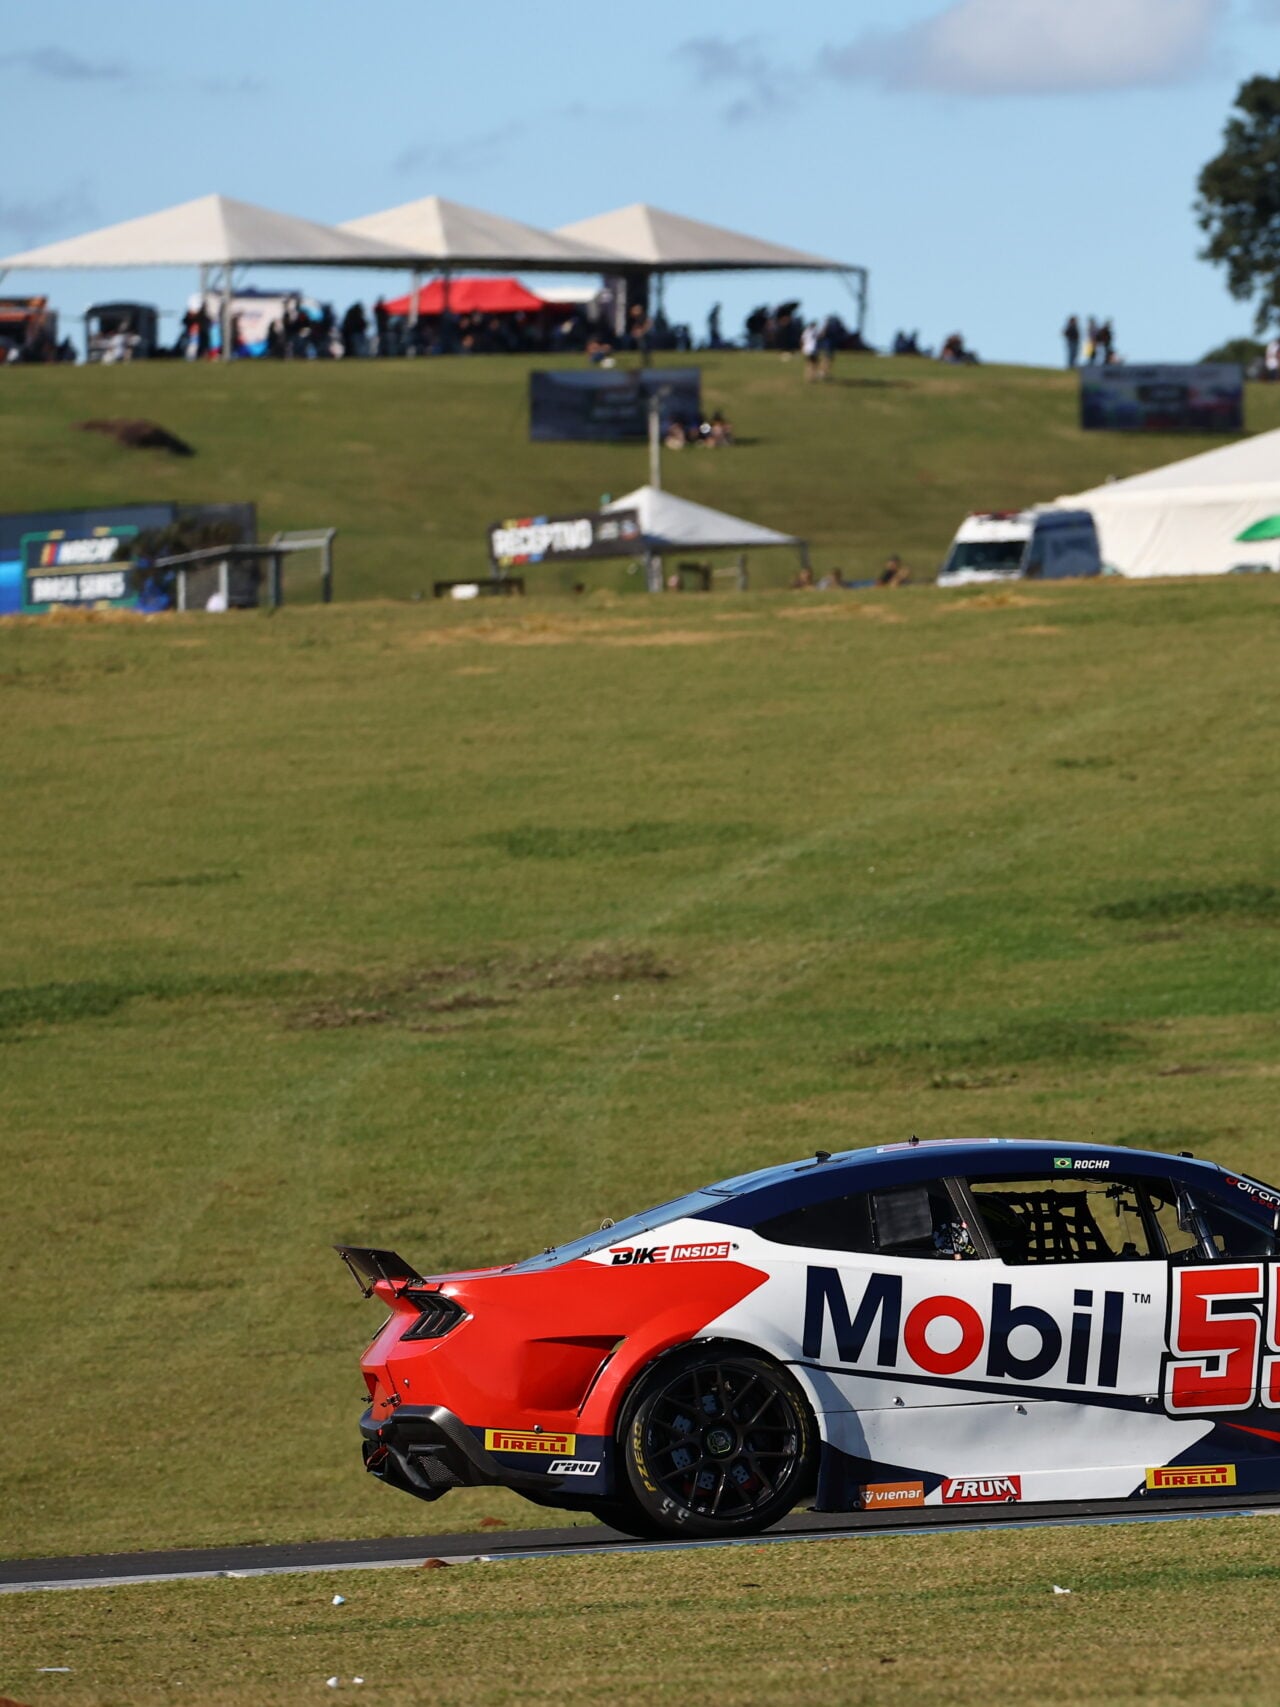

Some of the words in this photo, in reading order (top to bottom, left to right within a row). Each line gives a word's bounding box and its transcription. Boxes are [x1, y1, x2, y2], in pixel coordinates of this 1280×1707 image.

[1074, 1160, 1110, 1169] ROCHA
[609, 1246, 670, 1265] BIKE
[674, 1244, 728, 1259] INSIDE
[802, 1265, 1125, 1388] Mobil
[493, 1432, 567, 1453] PIRELLI
[1153, 1467, 1228, 1486] PIRELLI
[876, 1490, 922, 1500] viemar
[945, 1476, 1018, 1499] FRUM
